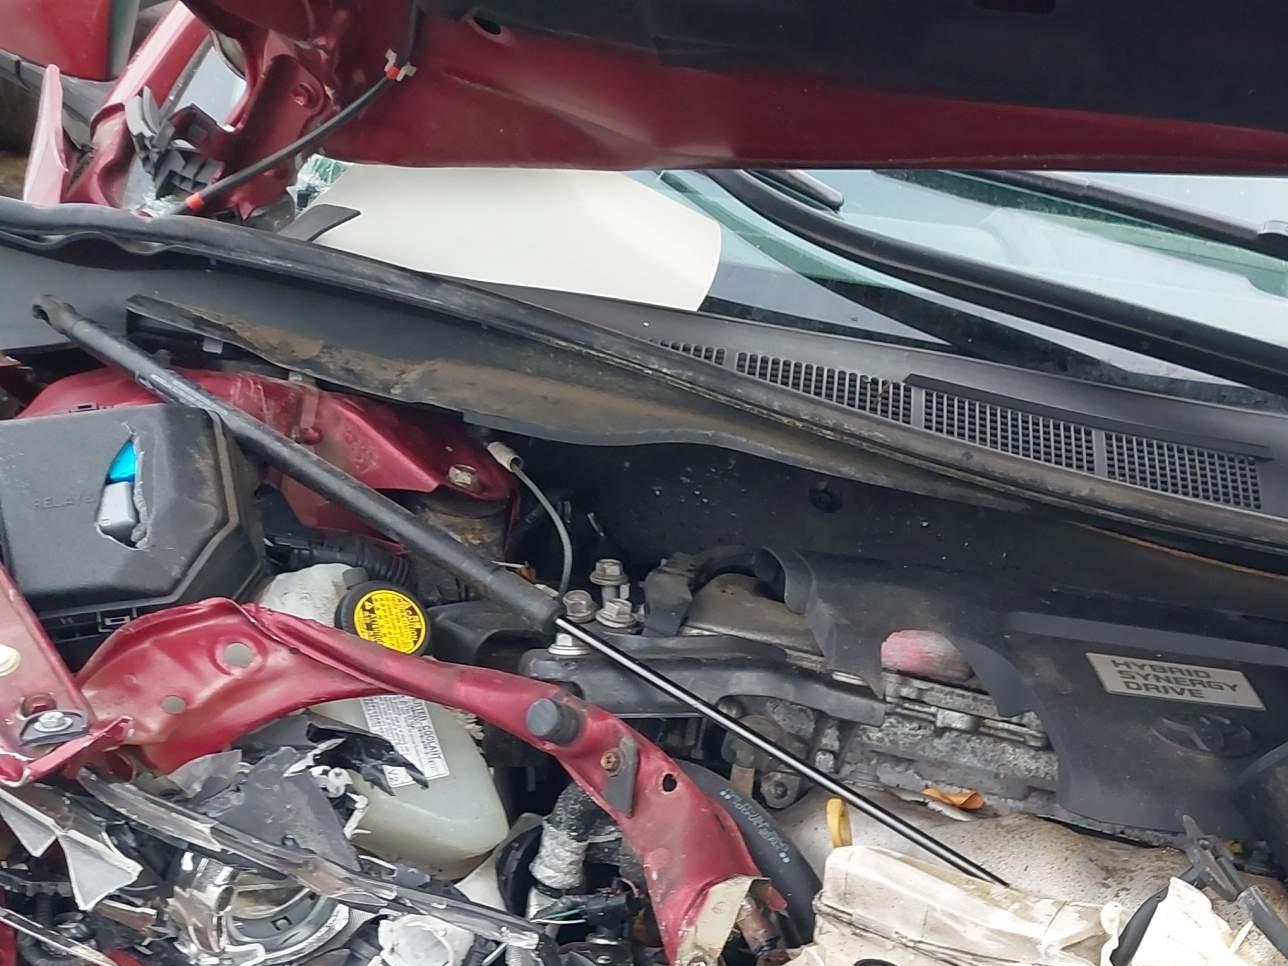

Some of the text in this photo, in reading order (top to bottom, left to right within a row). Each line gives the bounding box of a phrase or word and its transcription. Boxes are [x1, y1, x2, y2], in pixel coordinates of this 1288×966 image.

[1111, 660, 1210, 678] HYBRID
[1117, 670, 1238, 692] SYNERGY
[1123, 681, 1205, 698] DRIVE
